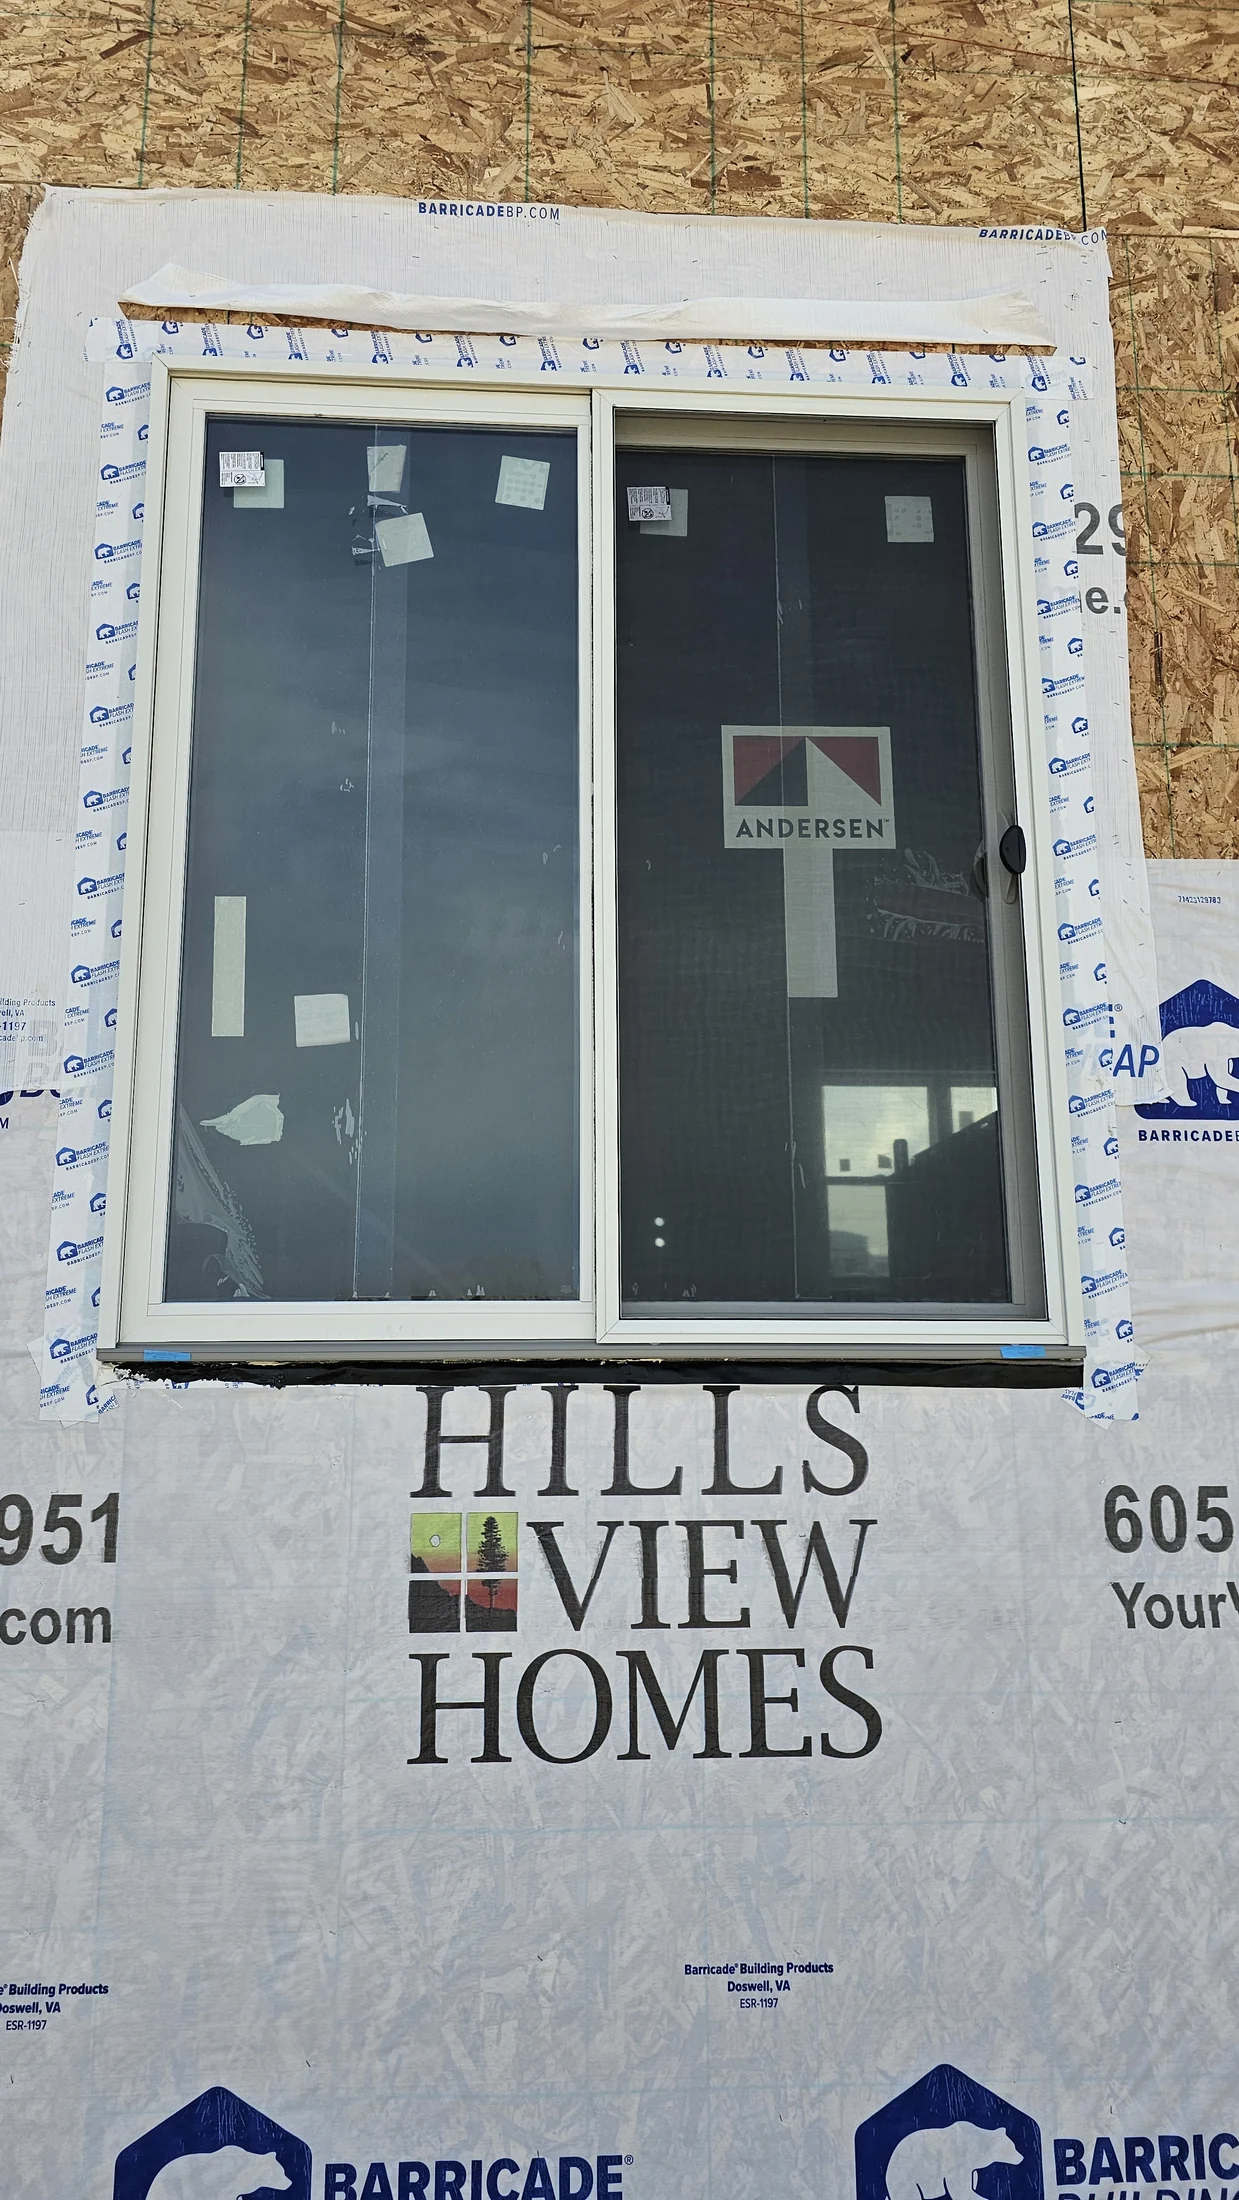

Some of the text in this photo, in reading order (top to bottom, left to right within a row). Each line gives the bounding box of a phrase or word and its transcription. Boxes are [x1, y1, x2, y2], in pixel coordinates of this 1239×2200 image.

[418, 202, 560, 220] BARRICADEBP.COM
[736, 818, 884, 838] ANDERSEN
[410, 1385, 869, 1498] HILLS
[1104, 1485, 1234, 1553] 605
[526, 1520, 878, 1631] VIEW
[407, 1645, 882, 1764] HOMES
[740, 1963, 783, 1976] Building
[787, 1962, 833, 1973] Products
[9, 1983, 55, 1997] Building
[59, 1983, 108, 1994] Products
[728, 1980, 790, 1993] Doswell, VA
[46, 2002, 61, 2012] VA
[740, 1998, 778, 2008] ESR-1197
[6, 2020, 47, 2030] ESR-1197
